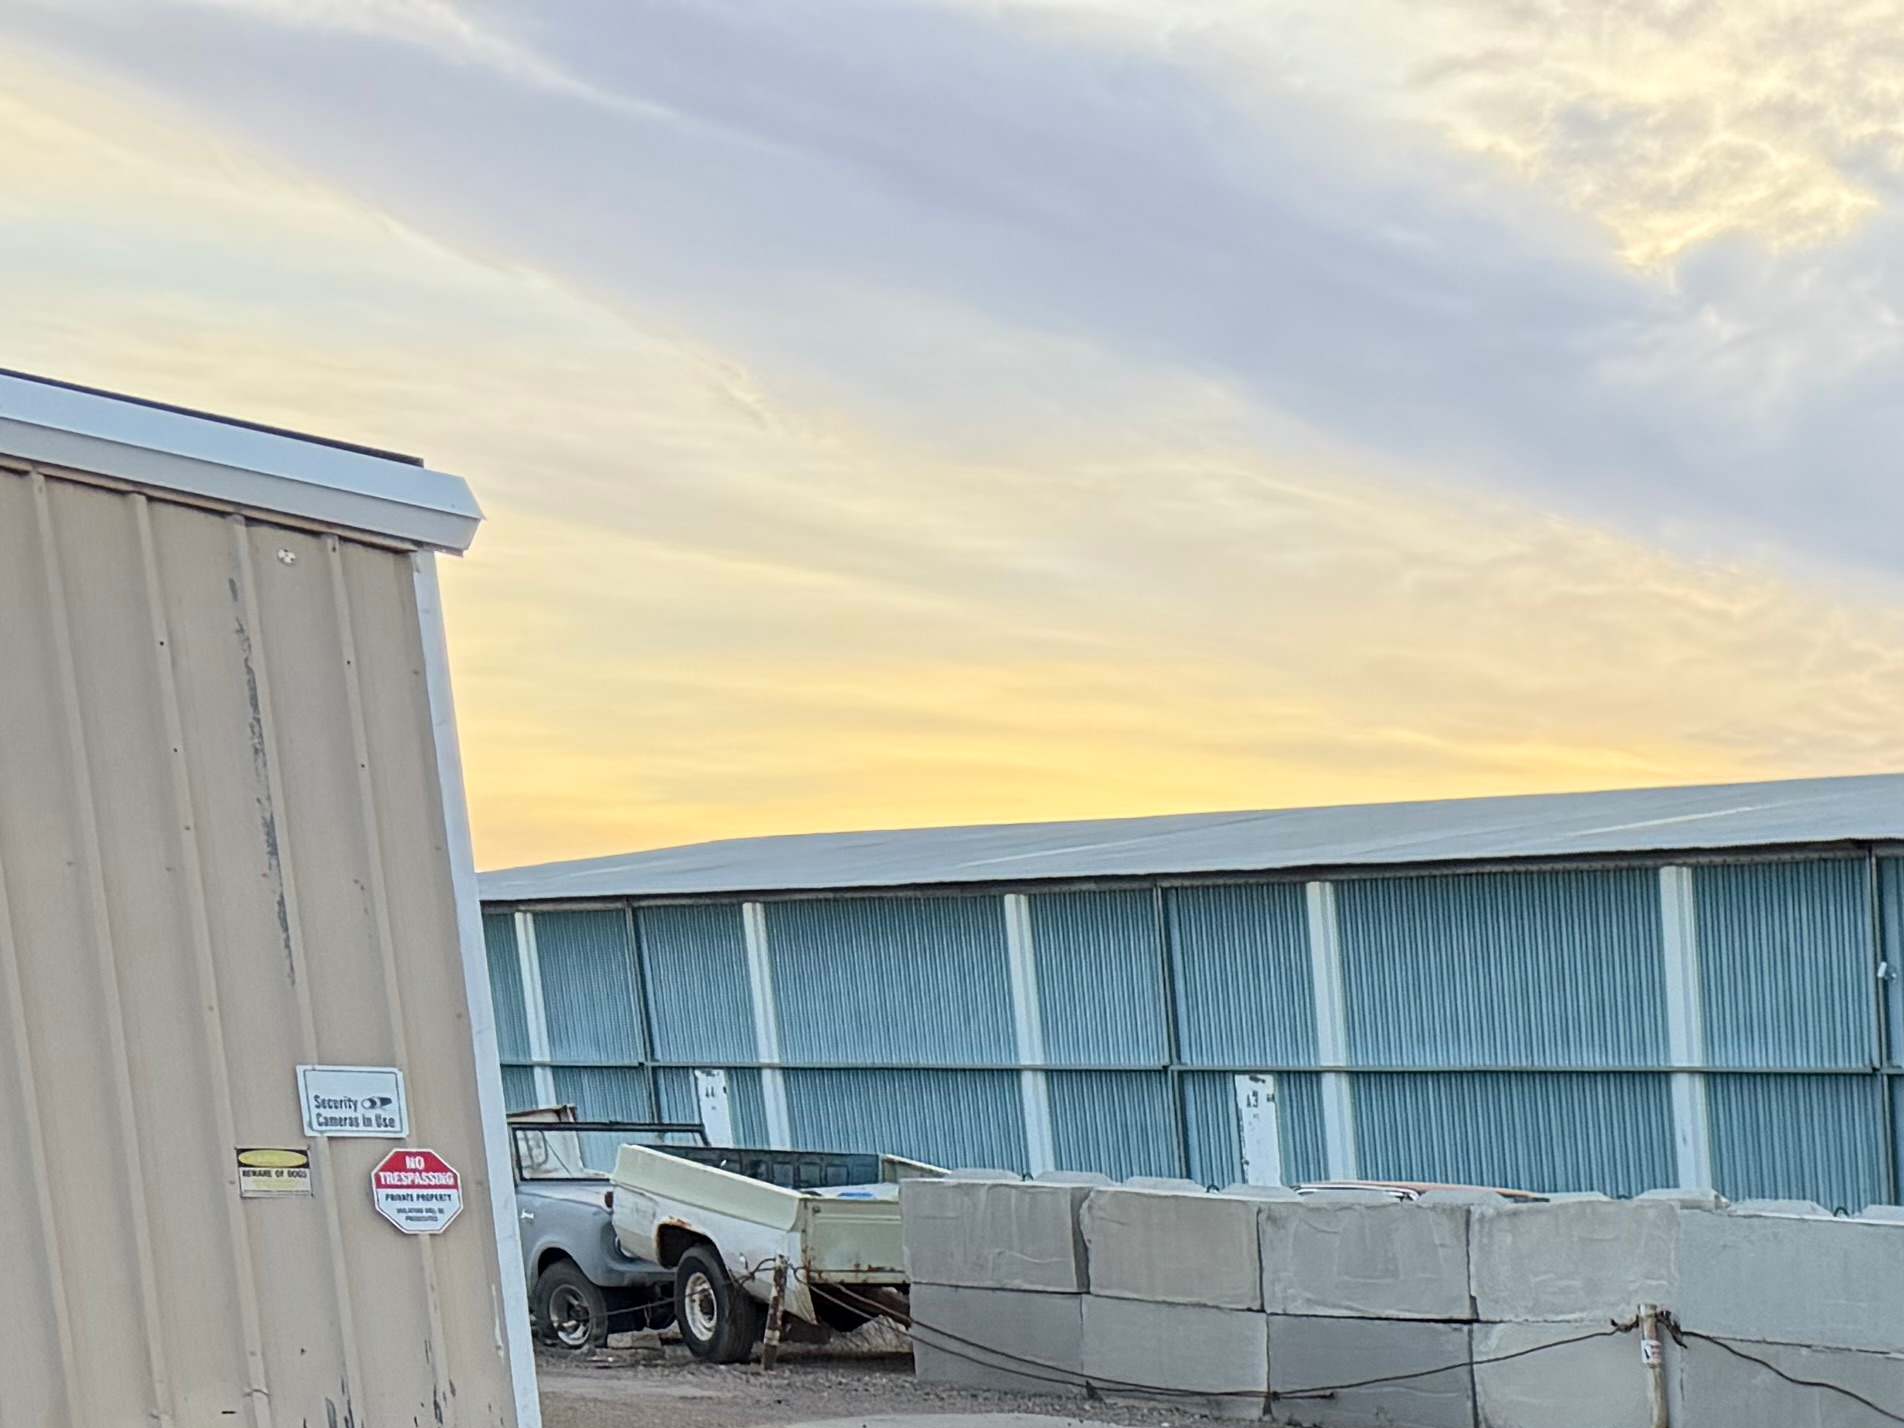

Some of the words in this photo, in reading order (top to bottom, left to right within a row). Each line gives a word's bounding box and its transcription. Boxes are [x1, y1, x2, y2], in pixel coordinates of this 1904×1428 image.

[313, 1094, 358, 1112] Security
[316, 1112, 360, 1128] Cameras
[375, 1113, 396, 1128] Use
[405, 1155, 425, 1170] NO
[242, 1170, 272, 1178] BEWARE
[275, 1170, 284, 1178] OF
[287, 1170, 308, 1178] DOGS
[379, 1171, 455, 1186] TRESPASSING
[416, 1193, 452, 1202] PROPERTY
